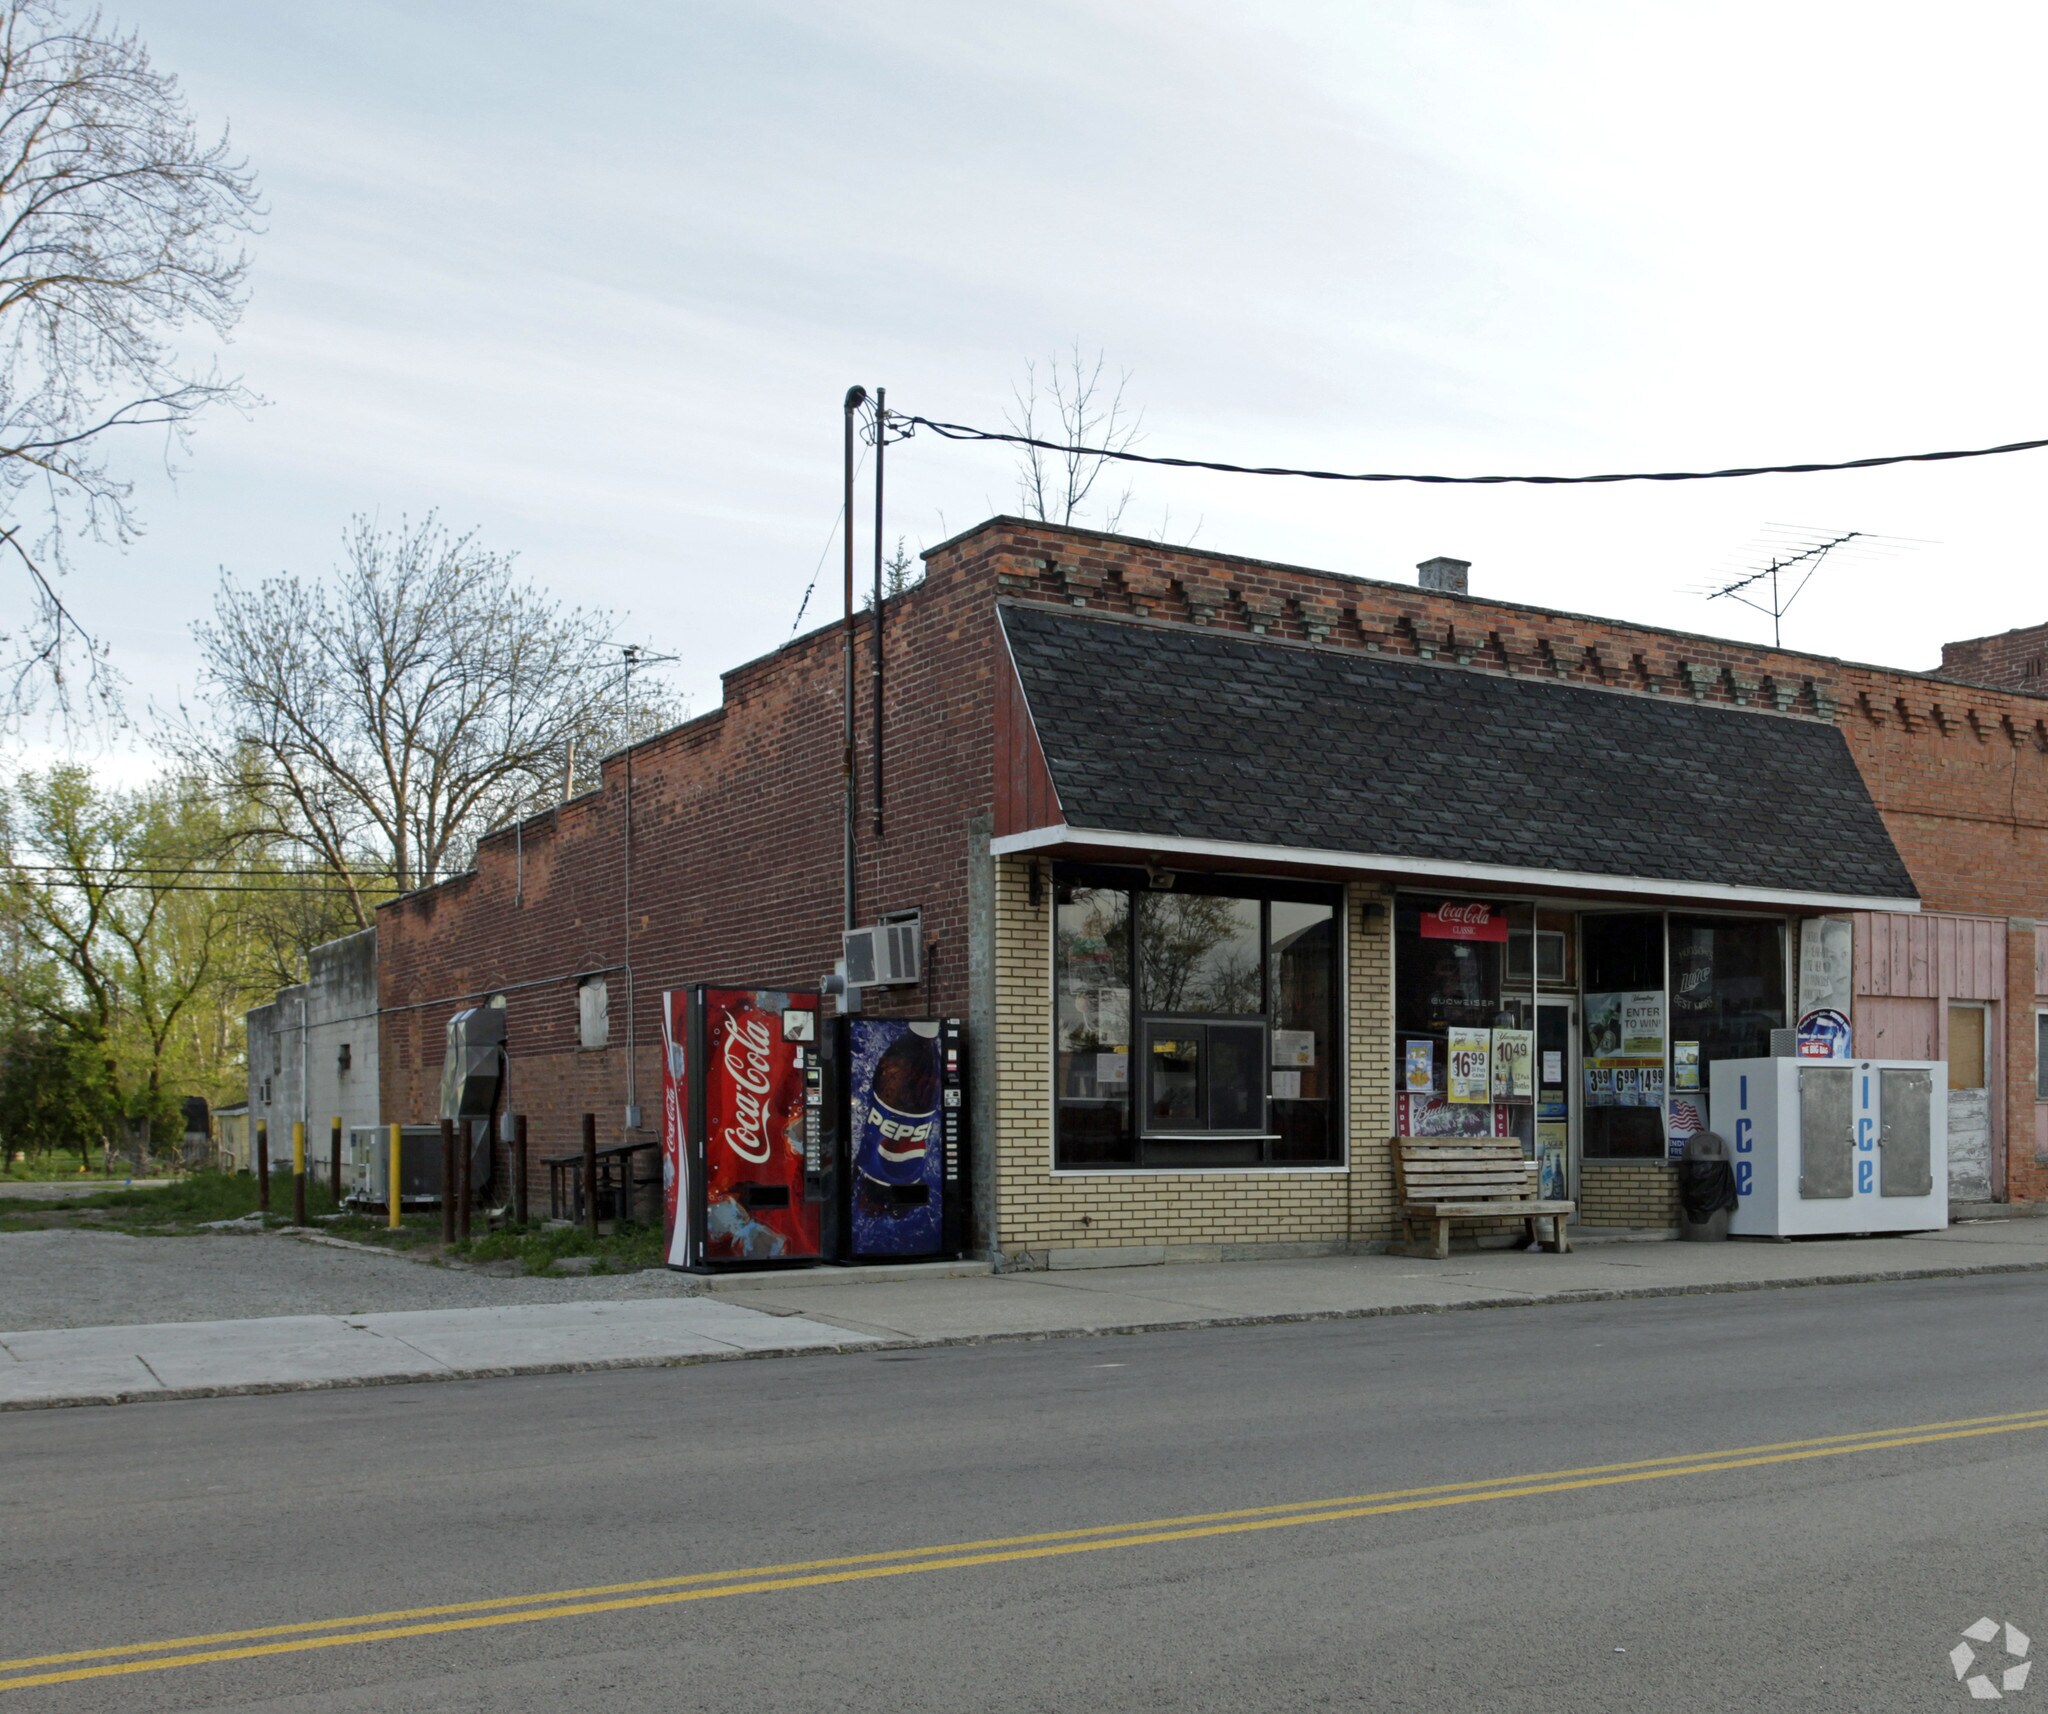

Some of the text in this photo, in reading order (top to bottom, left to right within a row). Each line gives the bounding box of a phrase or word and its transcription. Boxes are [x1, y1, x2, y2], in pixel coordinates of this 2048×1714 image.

[1438, 901, 1492, 924] Coca-Cola
[1452, 926, 1476, 935] CLASSIC
[1430, 997, 1496, 1007] BUDWEISER
[1626, 1007, 1660, 1017] ENTER
[1624, 1019, 1637, 1028] TO
[1809, 1044, 1819, 1054] BIG
[724, 1010, 770, 1165] Coca-Cola
[867, 1107, 933, 1142] PEPSI
